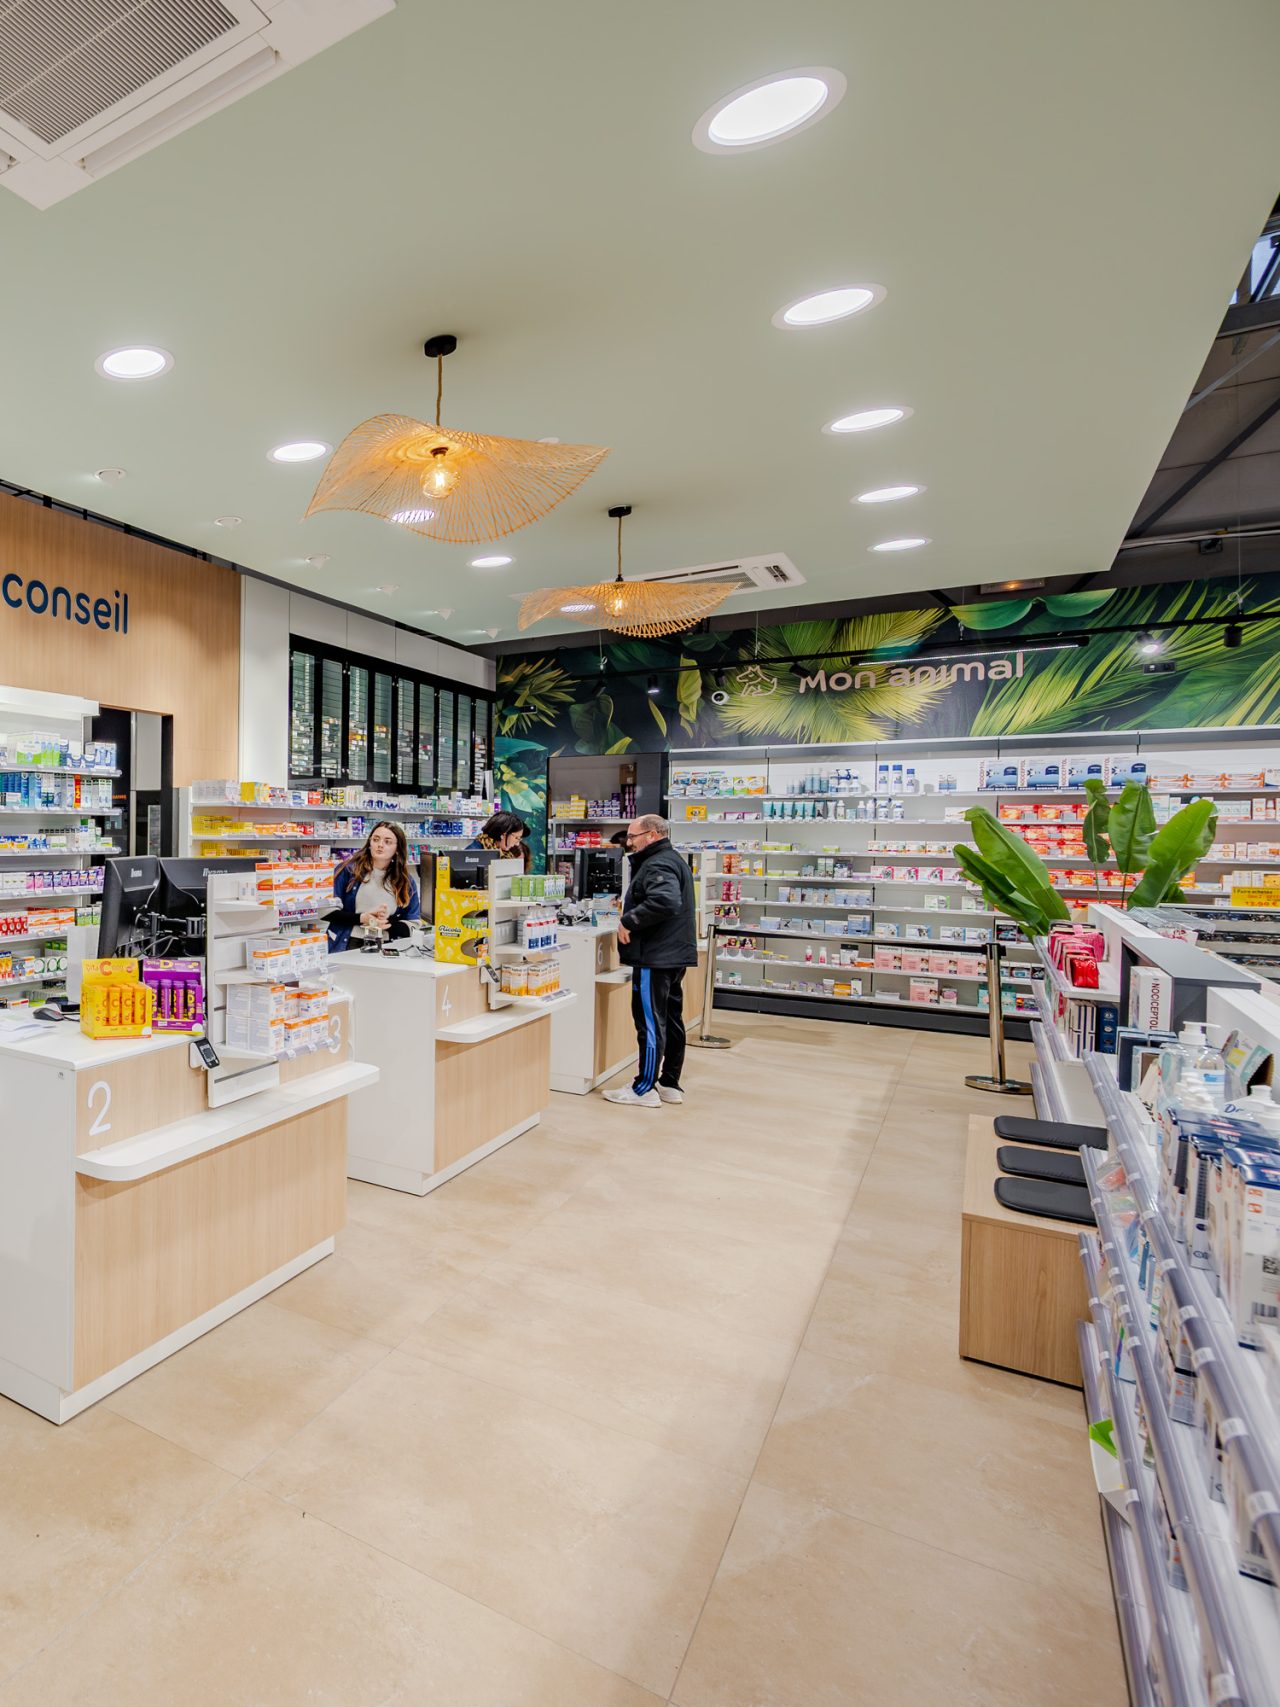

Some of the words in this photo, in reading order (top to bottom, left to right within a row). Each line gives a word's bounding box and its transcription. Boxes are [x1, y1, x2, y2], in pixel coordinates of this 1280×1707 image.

[0, 572, 129, 634] conseil
[799, 669, 876, 693] Mon
[888, 650, 1024, 687] animal
[441, 984, 452, 1017] 4
[1149, 981, 1160, 1031] NOCICEPTOL
[328, 1014, 342, 1054] 3
[87, 1080, 112, 1137] 2
